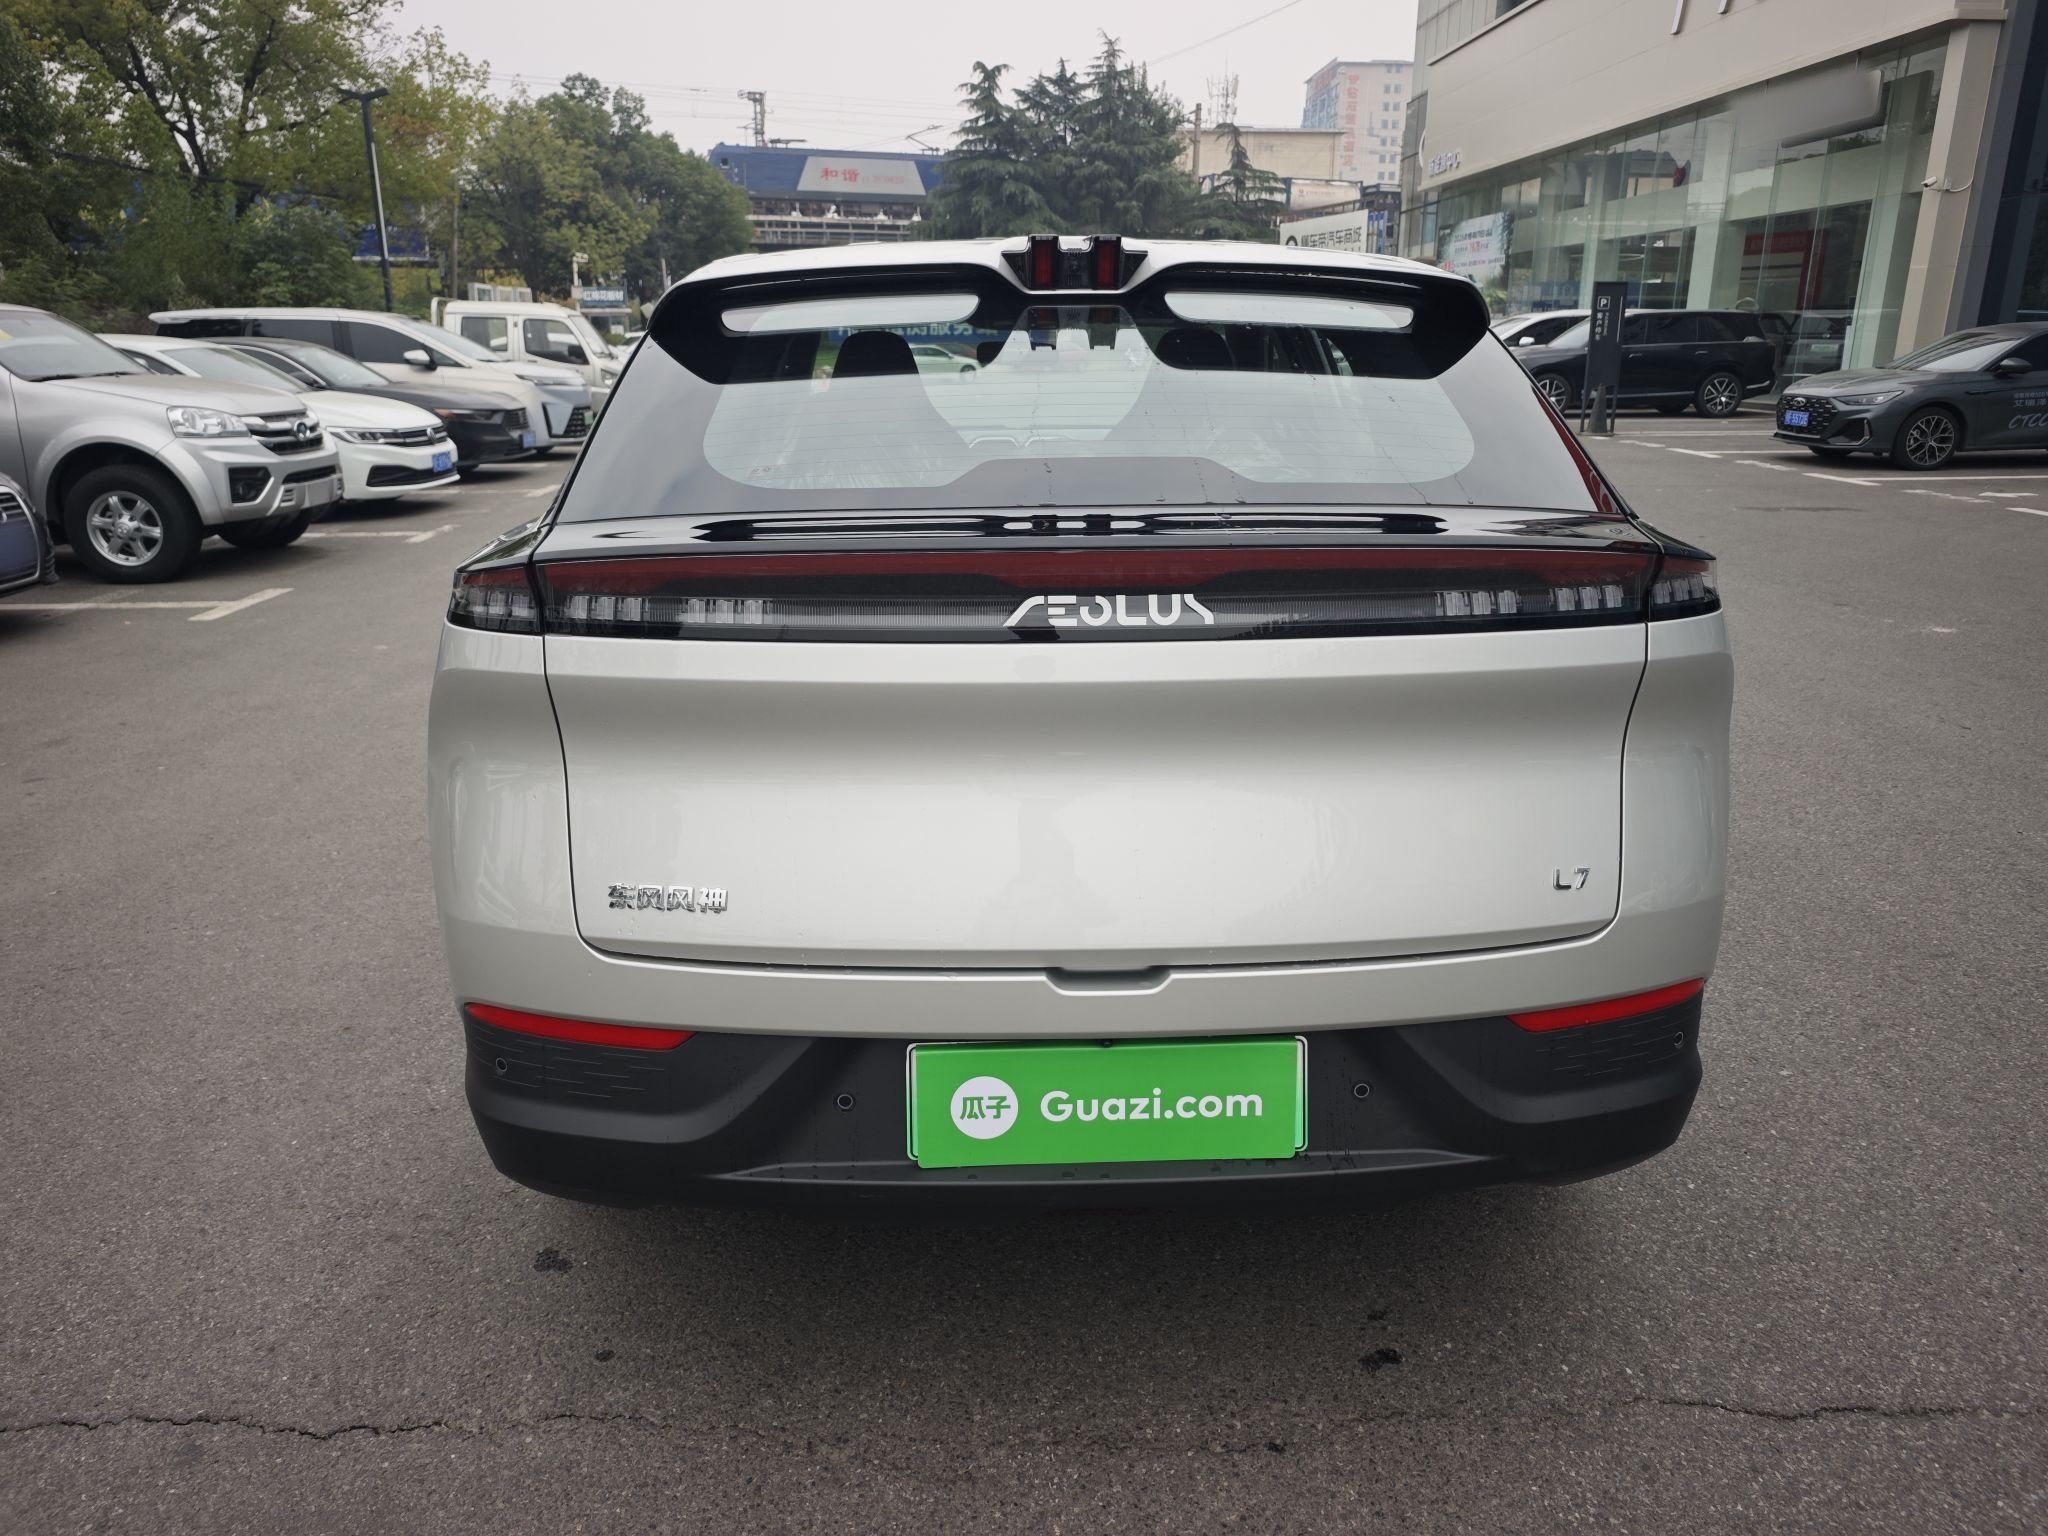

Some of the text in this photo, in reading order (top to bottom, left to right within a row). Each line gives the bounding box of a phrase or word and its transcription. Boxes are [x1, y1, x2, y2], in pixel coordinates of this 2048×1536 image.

[820, 167, 859, 182] 和谐
[1552, 867, 1591, 891] L7
[608, 883, 729, 914] 东风风神
[960, 1087, 1263, 1122] 瓜子 Guazi.com
